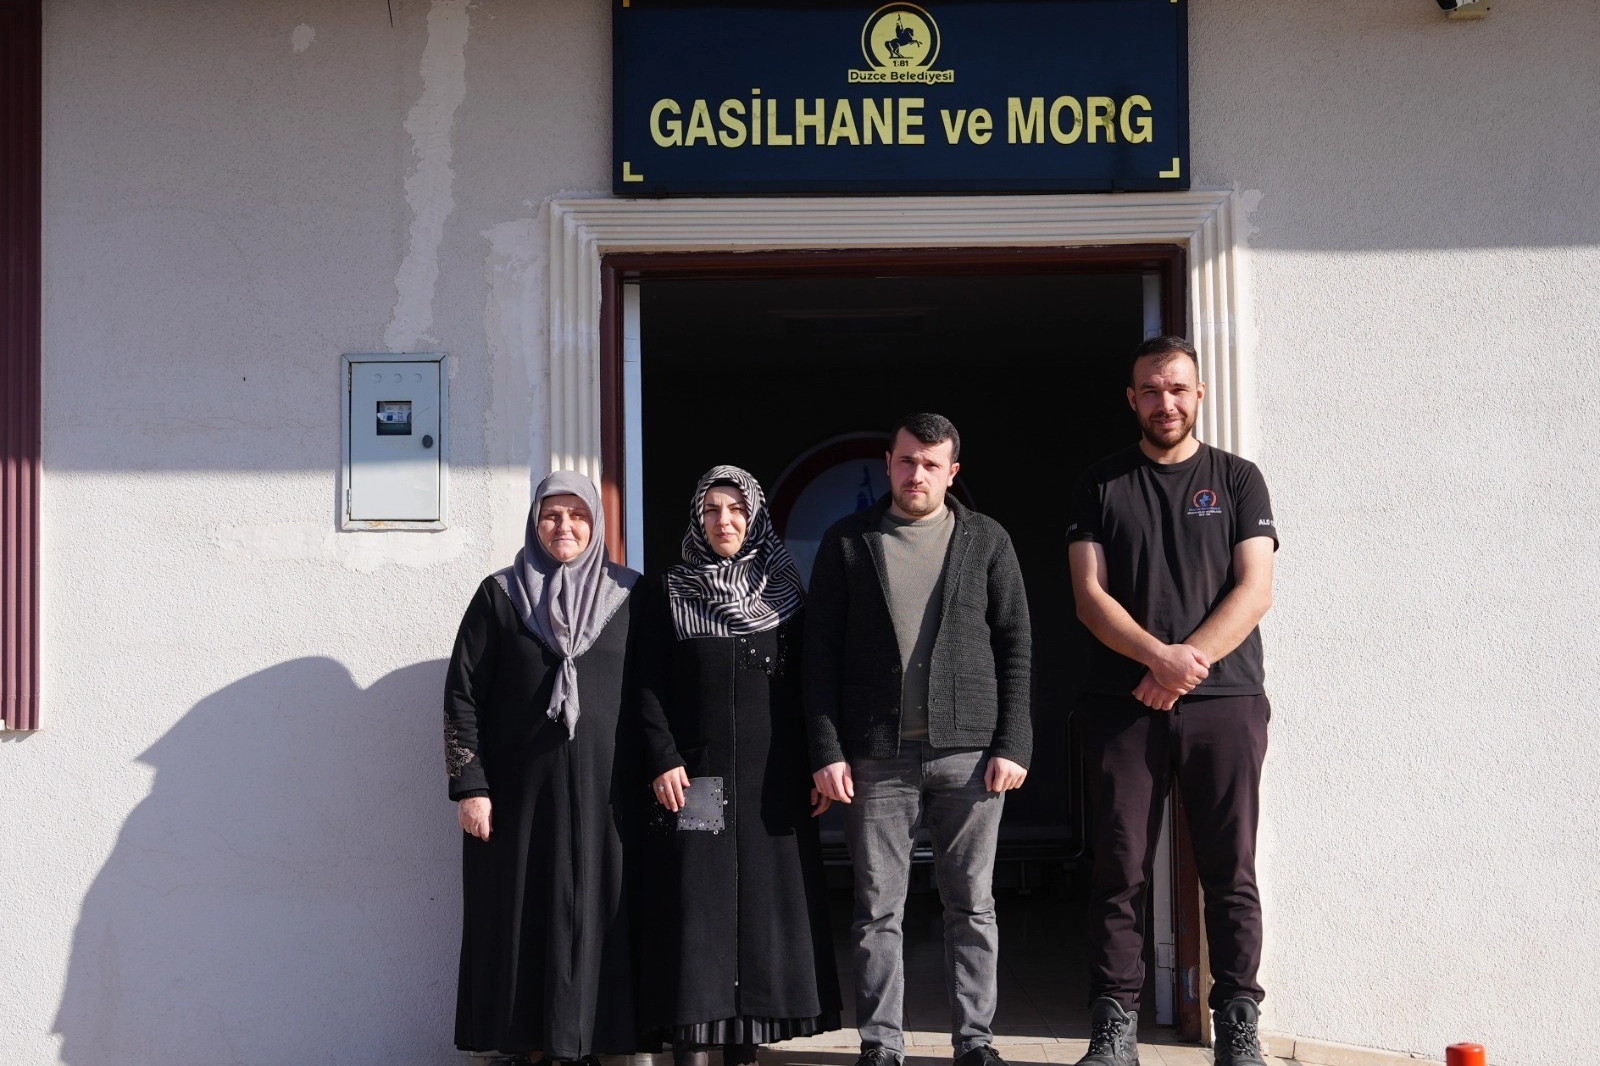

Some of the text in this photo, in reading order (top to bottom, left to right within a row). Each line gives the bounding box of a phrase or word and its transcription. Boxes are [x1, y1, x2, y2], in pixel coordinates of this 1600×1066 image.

[850, 71, 952, 83] Düzce Belediyesi
[649, 87, 1153, 148] GASİLHANE ve MORG
